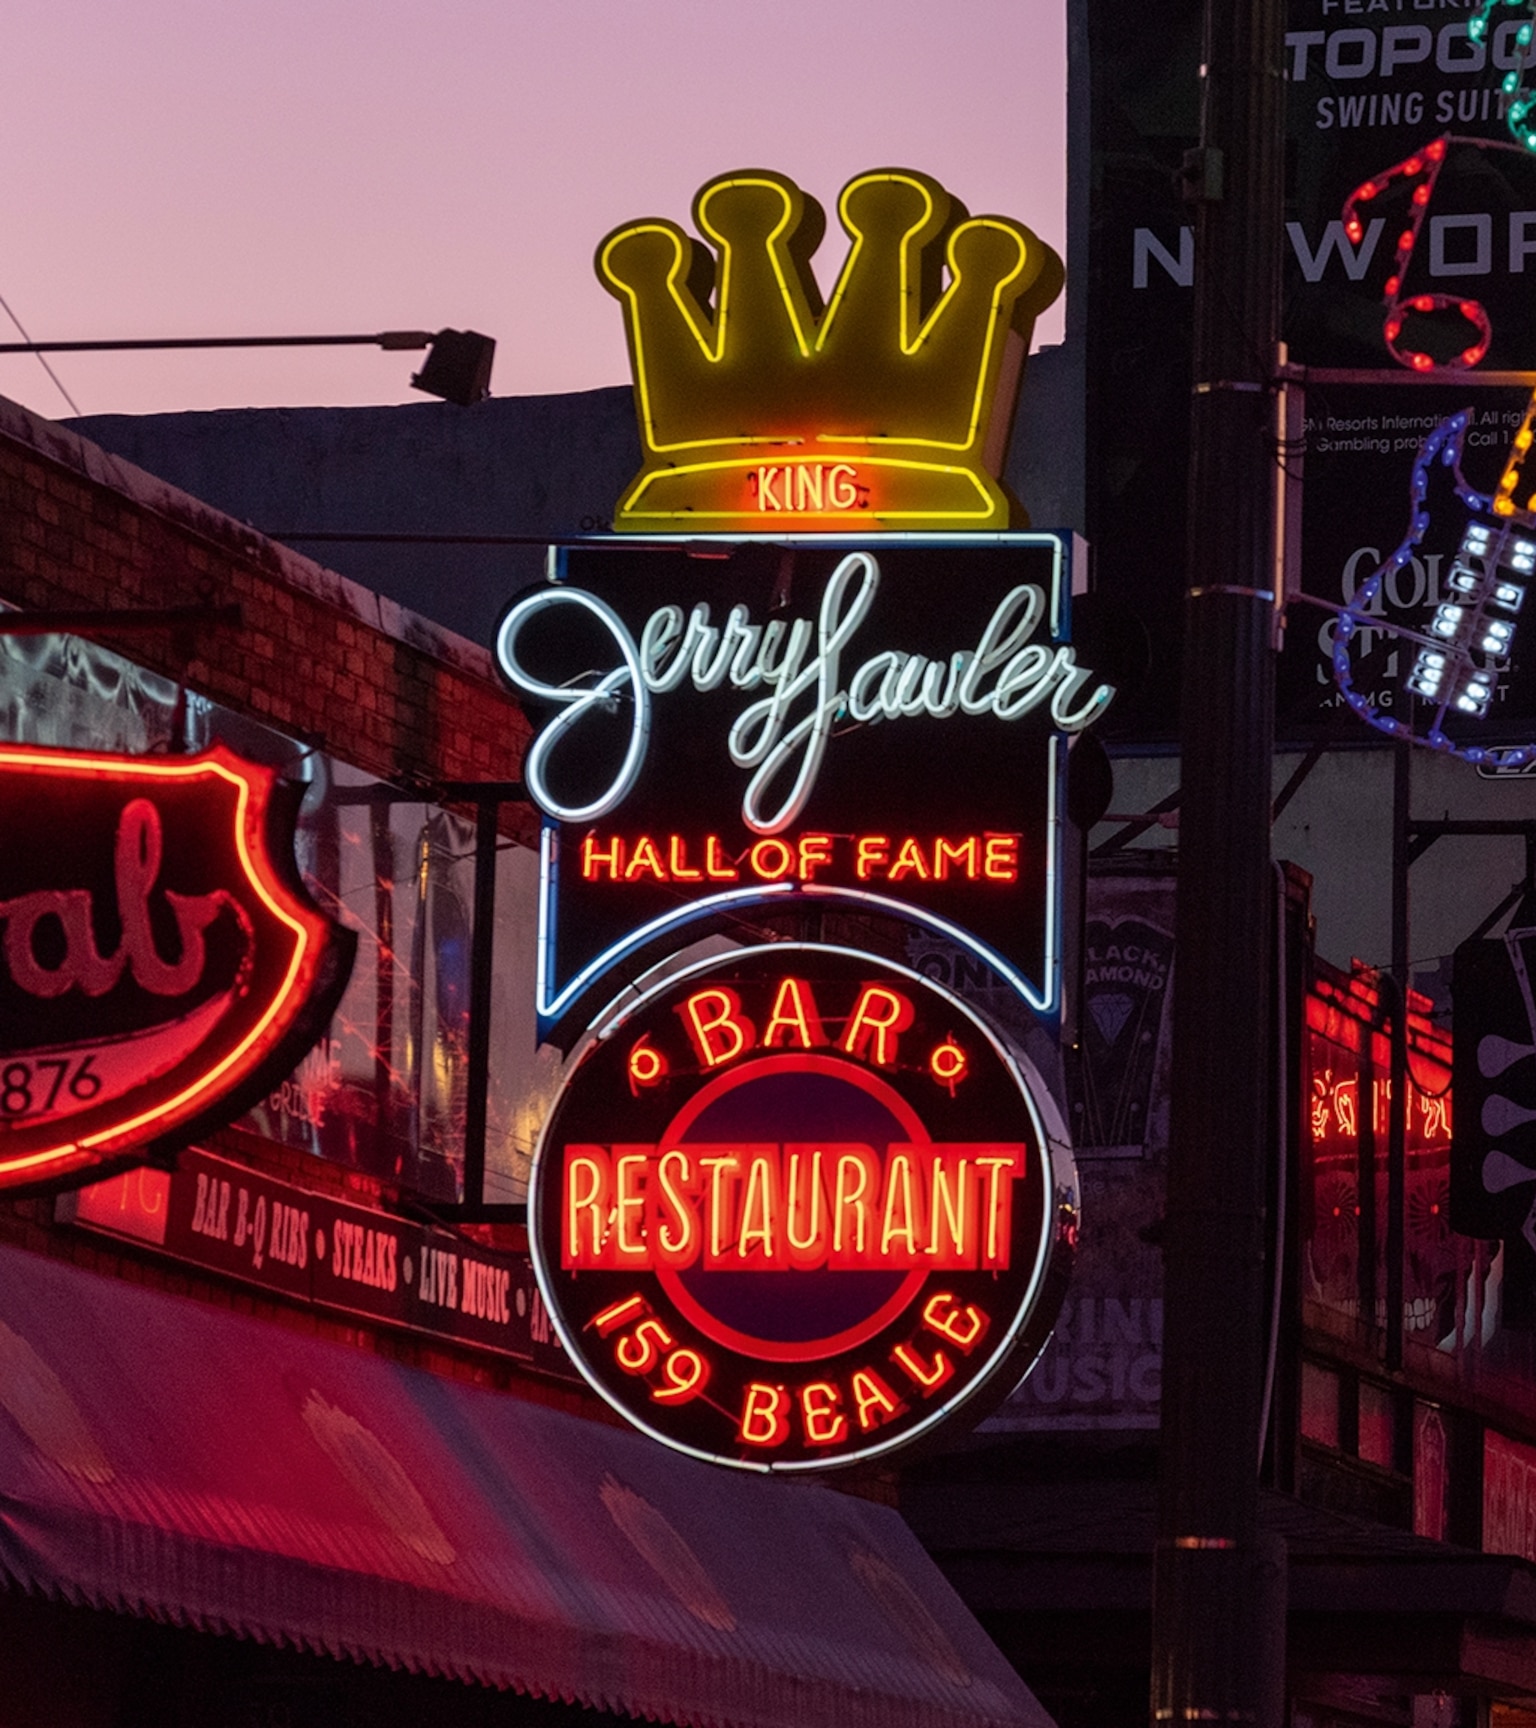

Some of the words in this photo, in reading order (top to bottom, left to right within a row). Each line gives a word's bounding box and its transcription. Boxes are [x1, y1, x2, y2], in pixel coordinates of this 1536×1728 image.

[1315, 91, 1425, 130] SWING
[1435, 86, 1532, 125] SUIT
[1132, 217, 1386, 290] NW
[1316, 436, 1391, 453] Gambling
[1468, 431, 1498, 447] Call
[1327, 414, 1379, 432] Resorts
[1480, 410, 1499, 426] All
[754, 463, 860, 513] KING
[496, 585, 812, 823] Jerry
[740, 551, 1117, 836] Lawler
[582, 834, 740, 882] HALL
[749, 834, 832, 882] OF
[852, 834, 1020, 882] FAME
[0, 797, 238, 998] ab
[1084, 965, 1164, 990] AMOND
[1087, 944, 1160, 970] LACK
[674, 976, 915, 1069] BAR
[562, 1142, 1027, 1272] RESTAURANT
[191, 1172, 231, 1242] BAR
[268, 1200, 310, 1270] RIBS
[332, 1218, 398, 1293] STEAKS
[418, 1245, 458, 1311] LIVE
[461, 1257, 511, 1326] MUSIC
[588, 1292, 712, 1405] 159
[735, 1290, 992, 1447] BEALE
[1014, 1353, 1163, 1403] USIC
